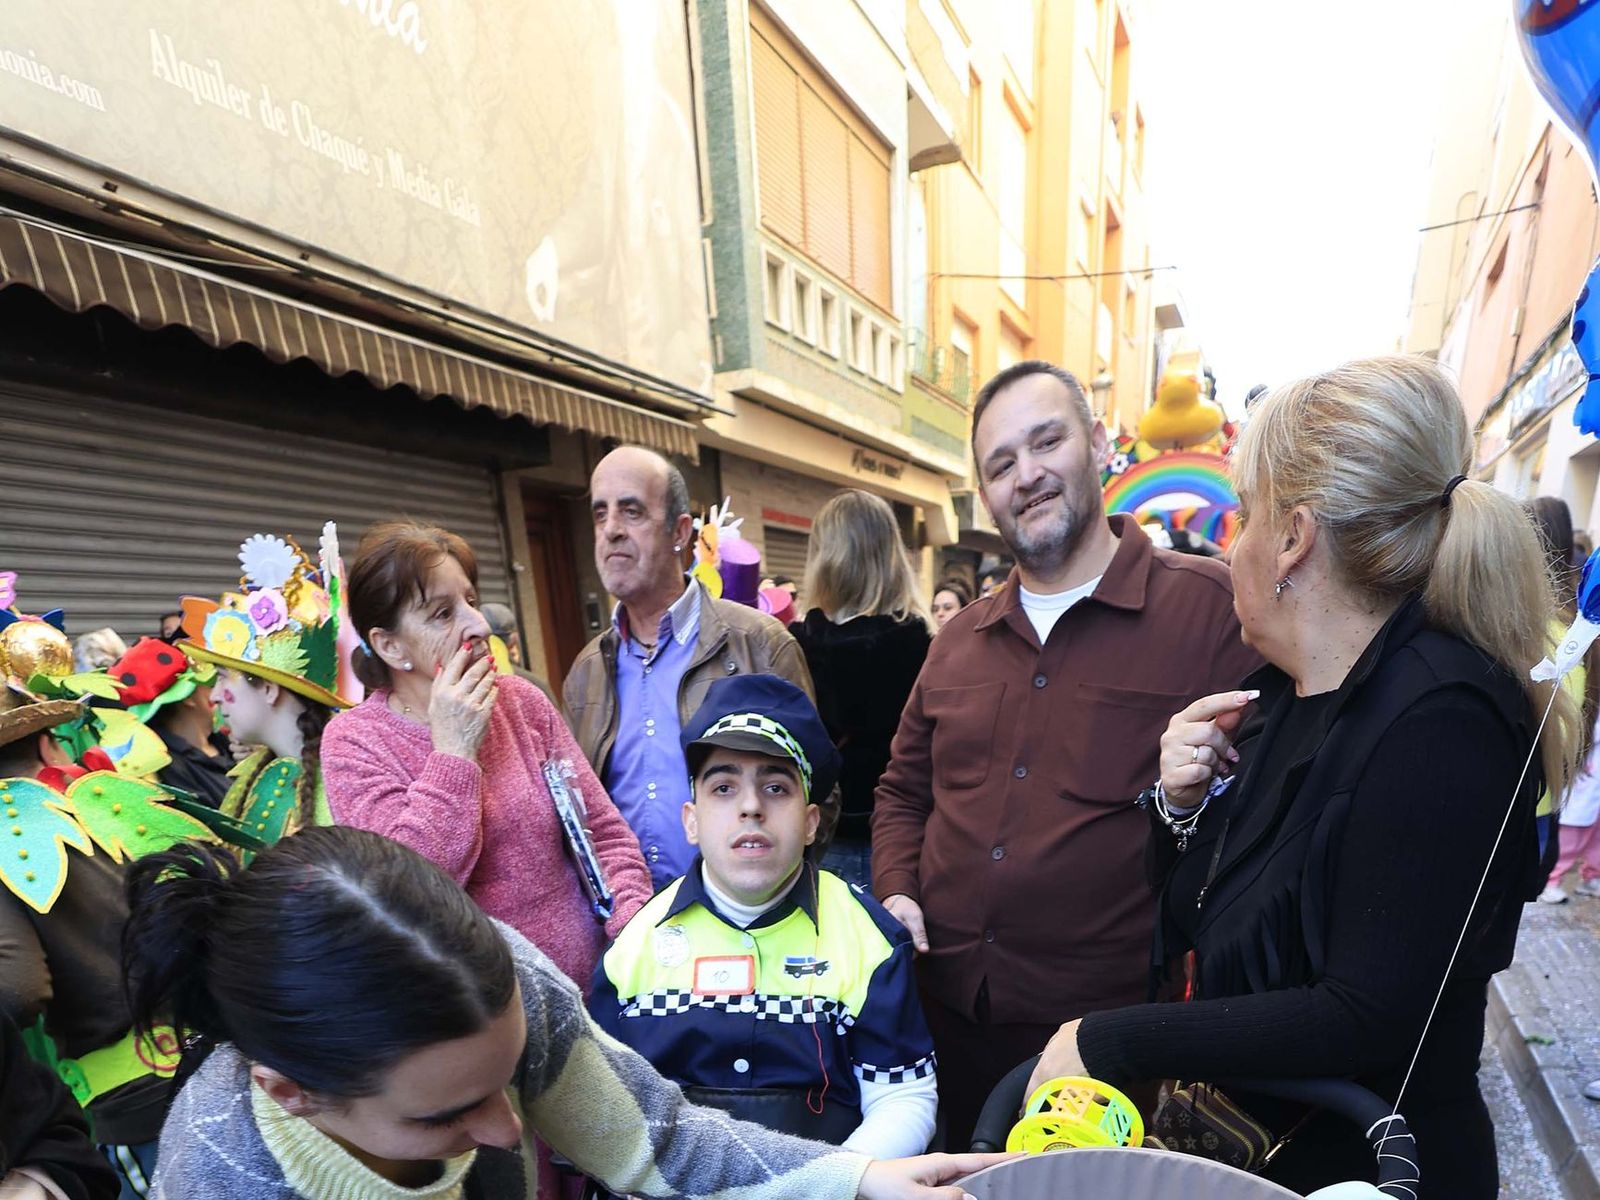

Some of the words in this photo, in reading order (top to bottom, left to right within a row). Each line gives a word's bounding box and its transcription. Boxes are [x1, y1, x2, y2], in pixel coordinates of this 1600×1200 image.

[148, 28, 251, 121] Alquiler
[259, 83, 289, 138] de
[291, 100, 371, 177] Chaqué
[372, 154, 384, 189] y
[386, 147, 443, 210] Media
[444, 176, 481, 228] Gala
